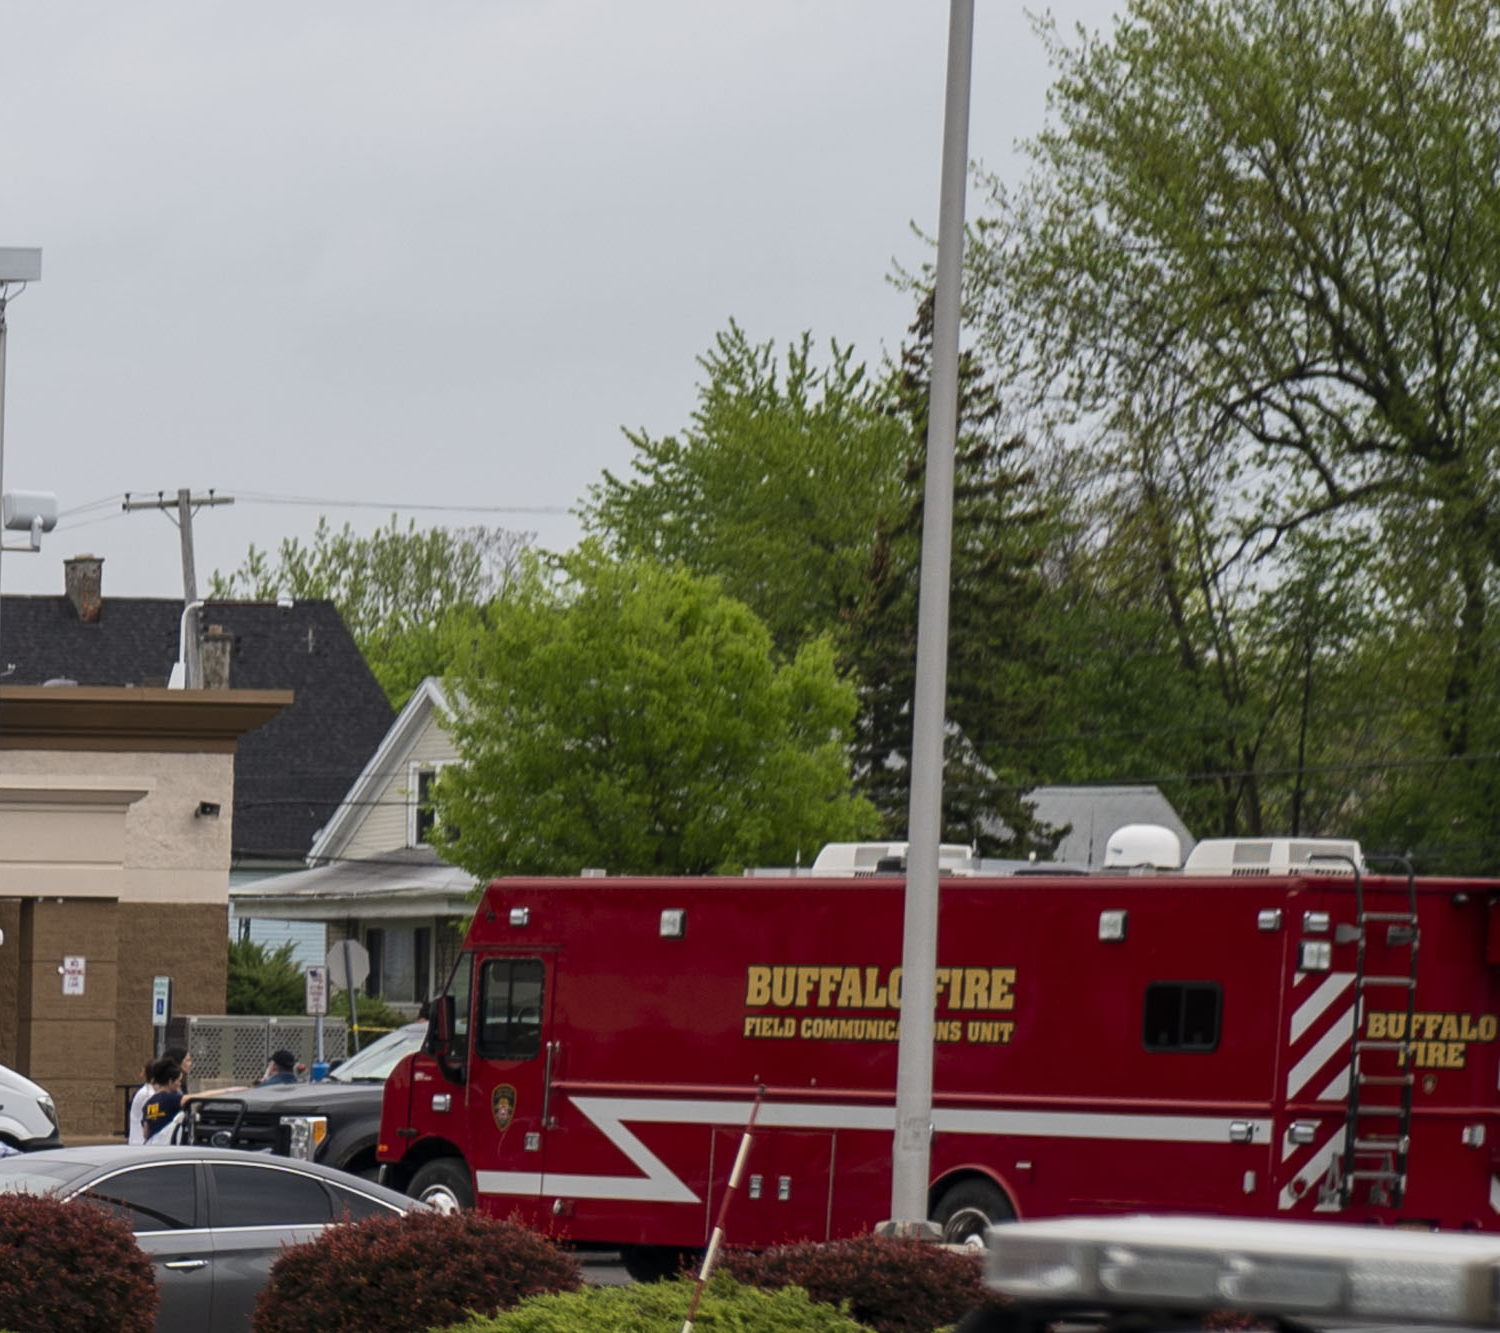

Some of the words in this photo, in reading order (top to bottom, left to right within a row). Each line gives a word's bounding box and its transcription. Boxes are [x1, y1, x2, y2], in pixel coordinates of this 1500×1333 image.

[743, 1017, 796, 1038] FIELD
[967, 1021, 1014, 1043] UNIT
[1366, 1012, 1498, 1041] BUFFALO
